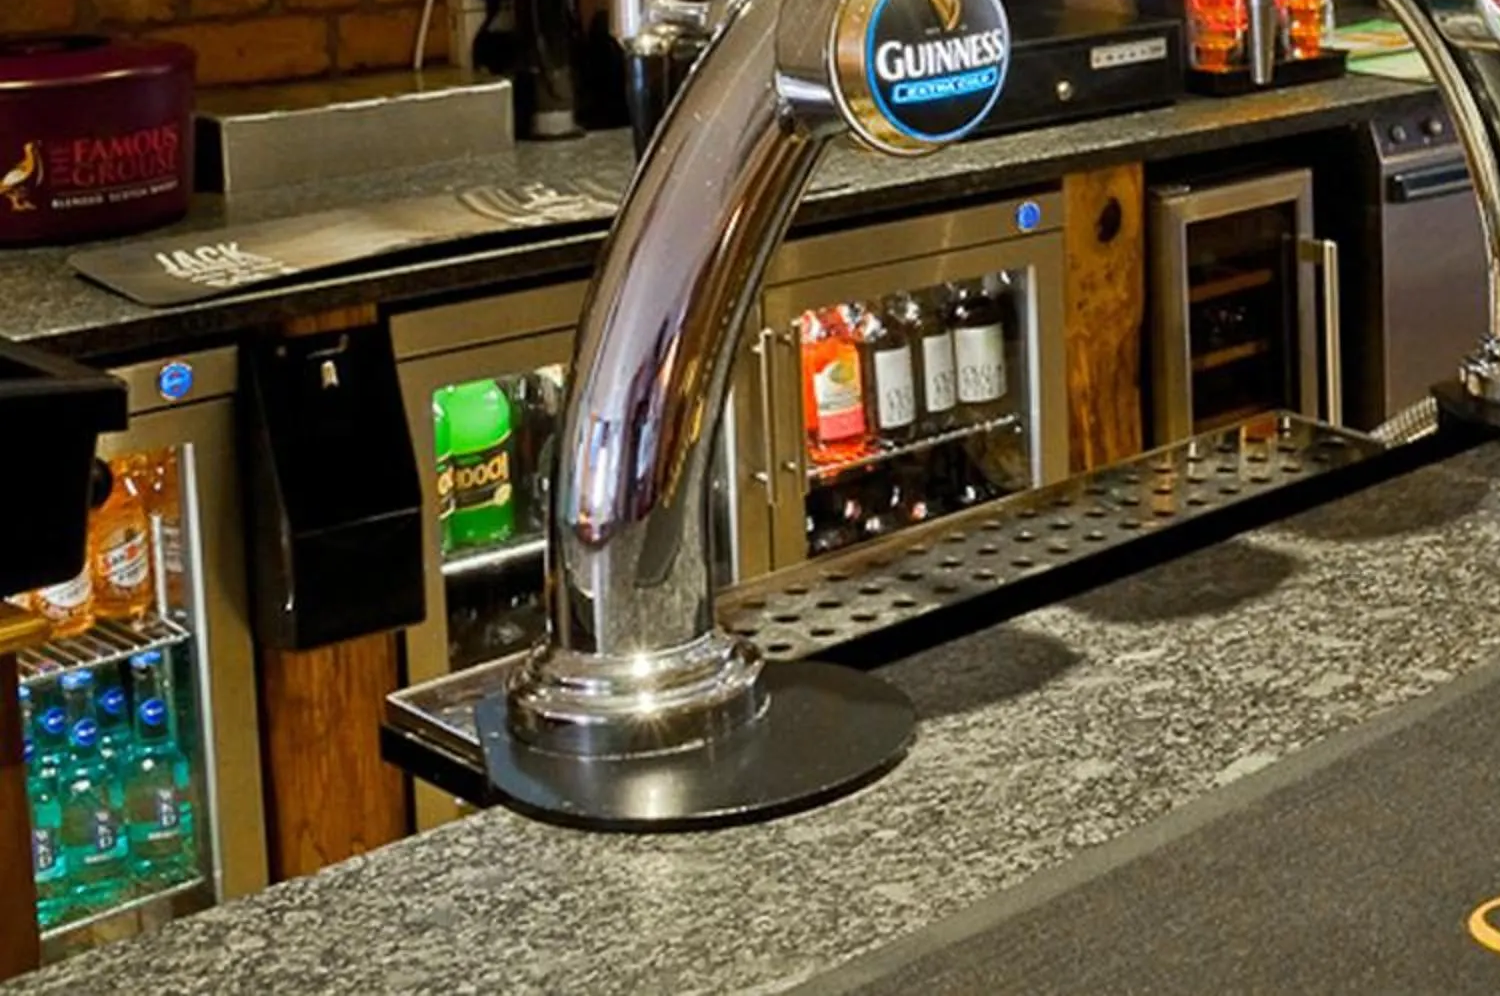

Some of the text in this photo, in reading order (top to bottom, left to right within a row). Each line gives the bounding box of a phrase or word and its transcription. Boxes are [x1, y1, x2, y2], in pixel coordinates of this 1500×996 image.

[876, 28, 1004, 82] GUINNESS
[73, 125, 178, 163] FAMOUS
[72, 153, 178, 188] GROUSE
[155, 242, 240, 277] JACK
